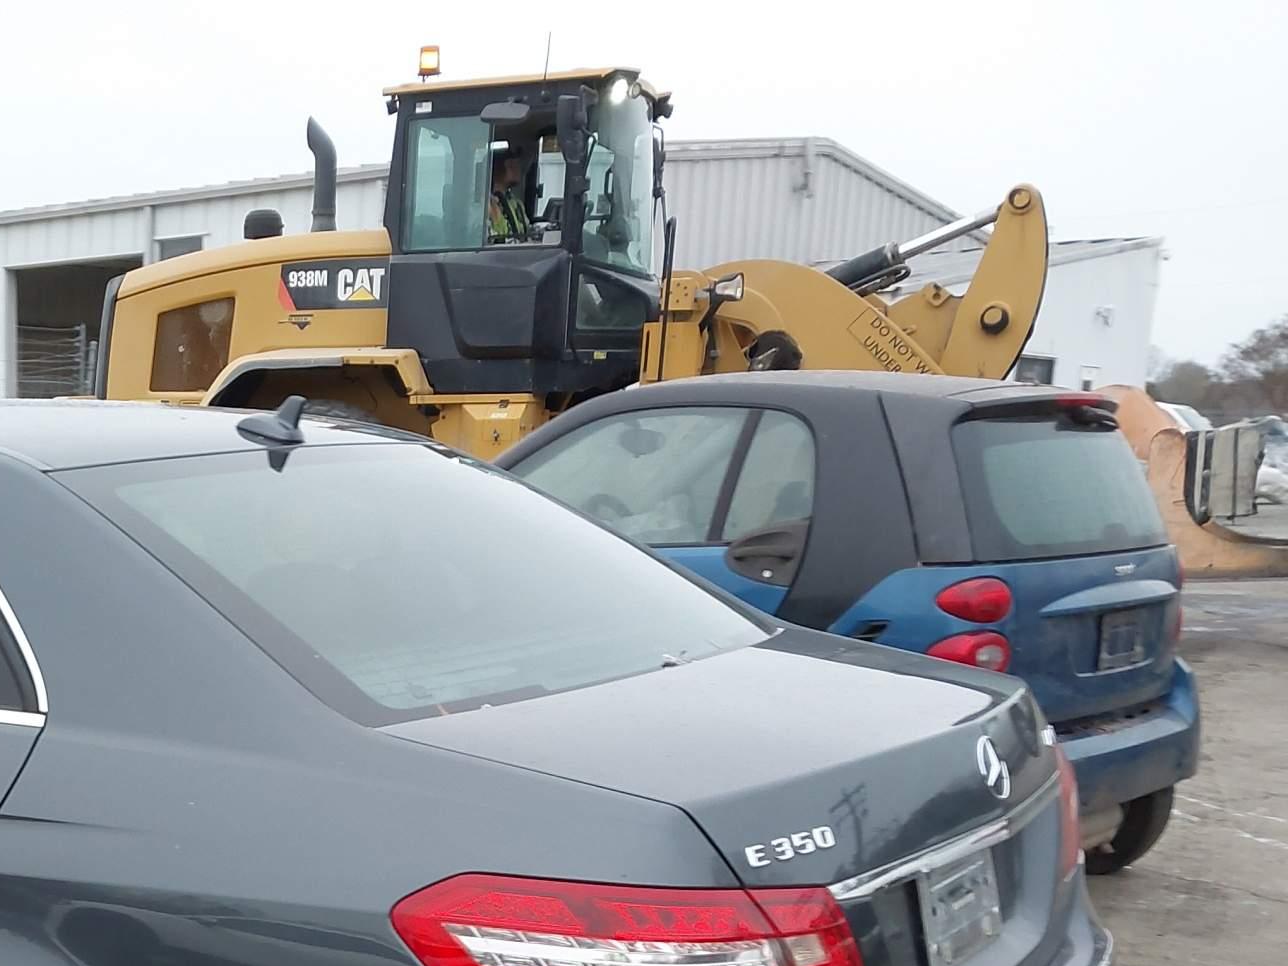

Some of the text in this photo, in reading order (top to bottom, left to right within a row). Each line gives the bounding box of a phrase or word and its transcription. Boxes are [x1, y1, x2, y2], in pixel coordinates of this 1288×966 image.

[288, 268, 386, 301] 938M CAT
[863, 335, 902, 373] UNDER
[870, 316, 890, 337] DO
[888, 335, 919, 362] NOT
[744, 826, 836, 868] E 350
